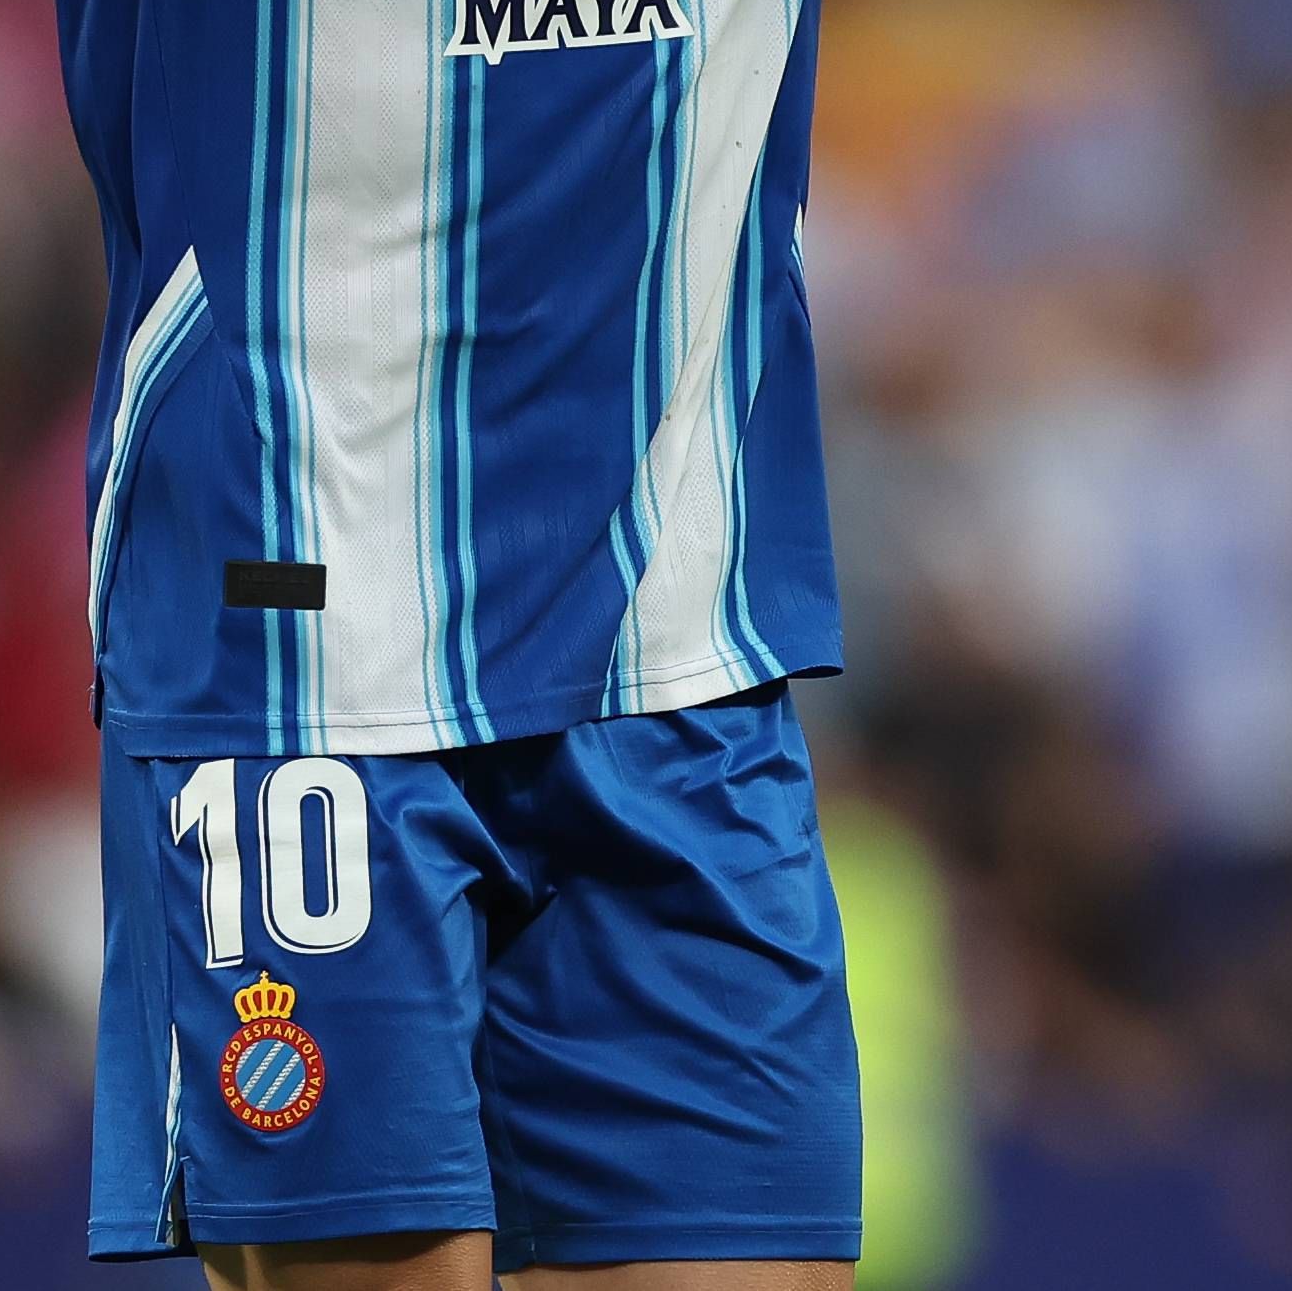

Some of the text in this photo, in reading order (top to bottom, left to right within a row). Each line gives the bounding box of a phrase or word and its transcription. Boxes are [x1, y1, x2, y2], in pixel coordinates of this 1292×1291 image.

[170, 757, 373, 970] 10
[222, 1023, 319, 1073] RCD ESPANYOL
[224, 1076, 321, 1127] DE BARCELONA
